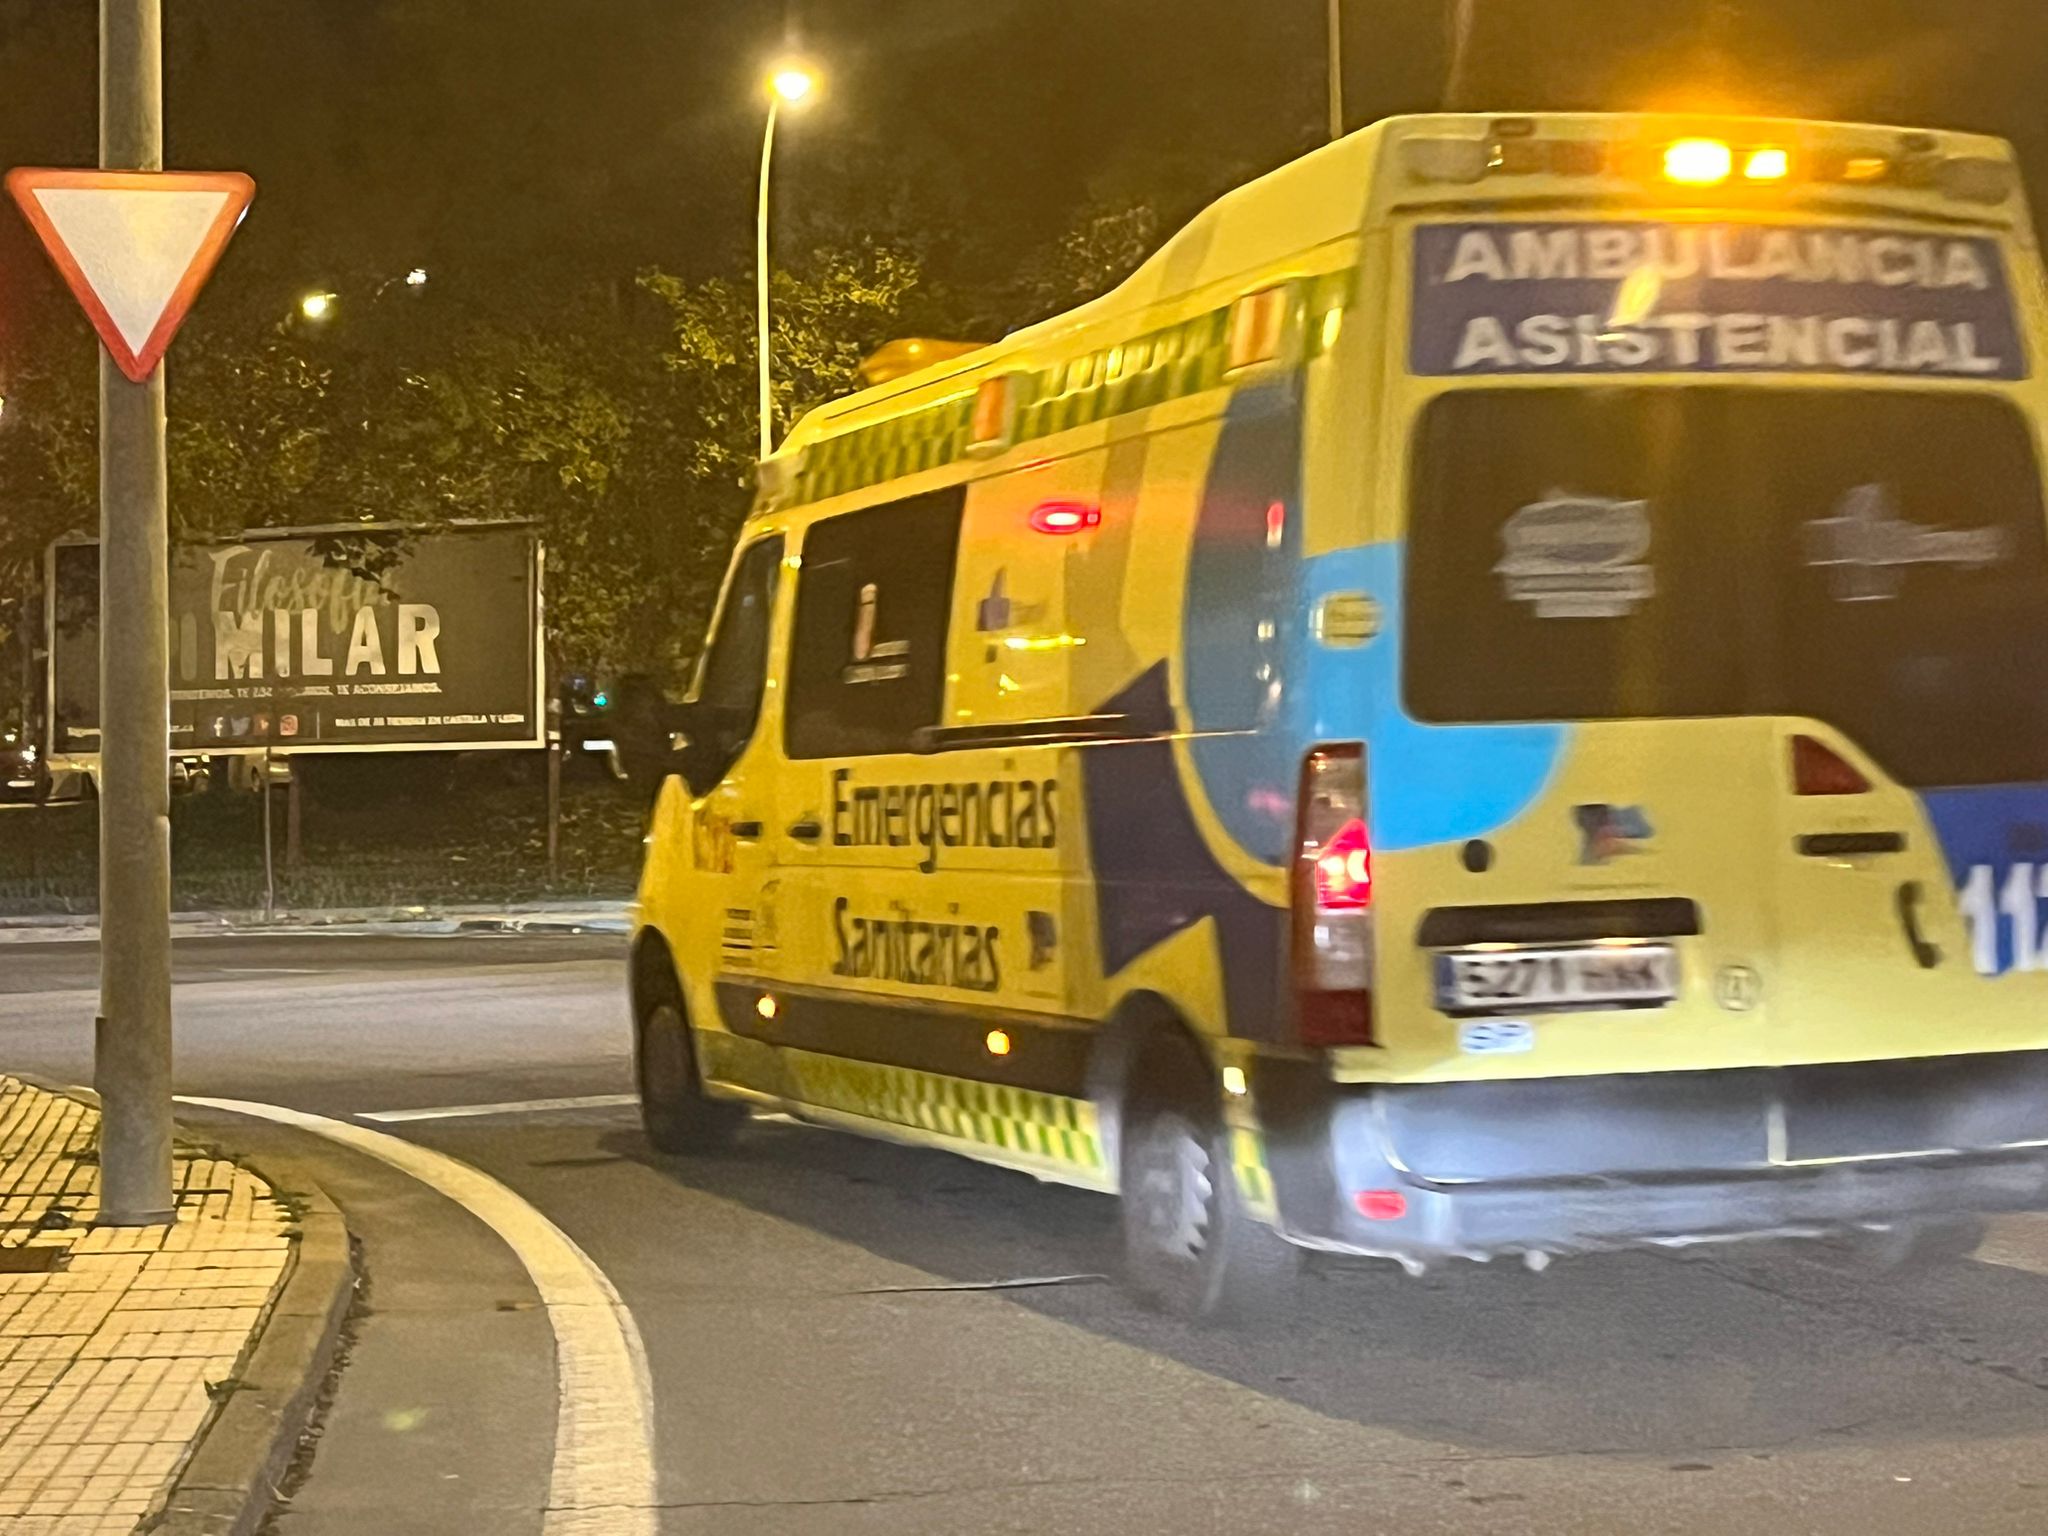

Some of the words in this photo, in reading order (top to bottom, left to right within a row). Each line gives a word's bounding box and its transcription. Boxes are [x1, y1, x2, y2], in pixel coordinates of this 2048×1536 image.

[1443, 228, 1989, 289] AMBULANCIA
[1453, 314, 2001, 373] ASISTENCIAL
[215, 603, 441, 680] MILAR
[831, 757, 1058, 874] Emergencias
[832, 897, 999, 993] Sanitarias
